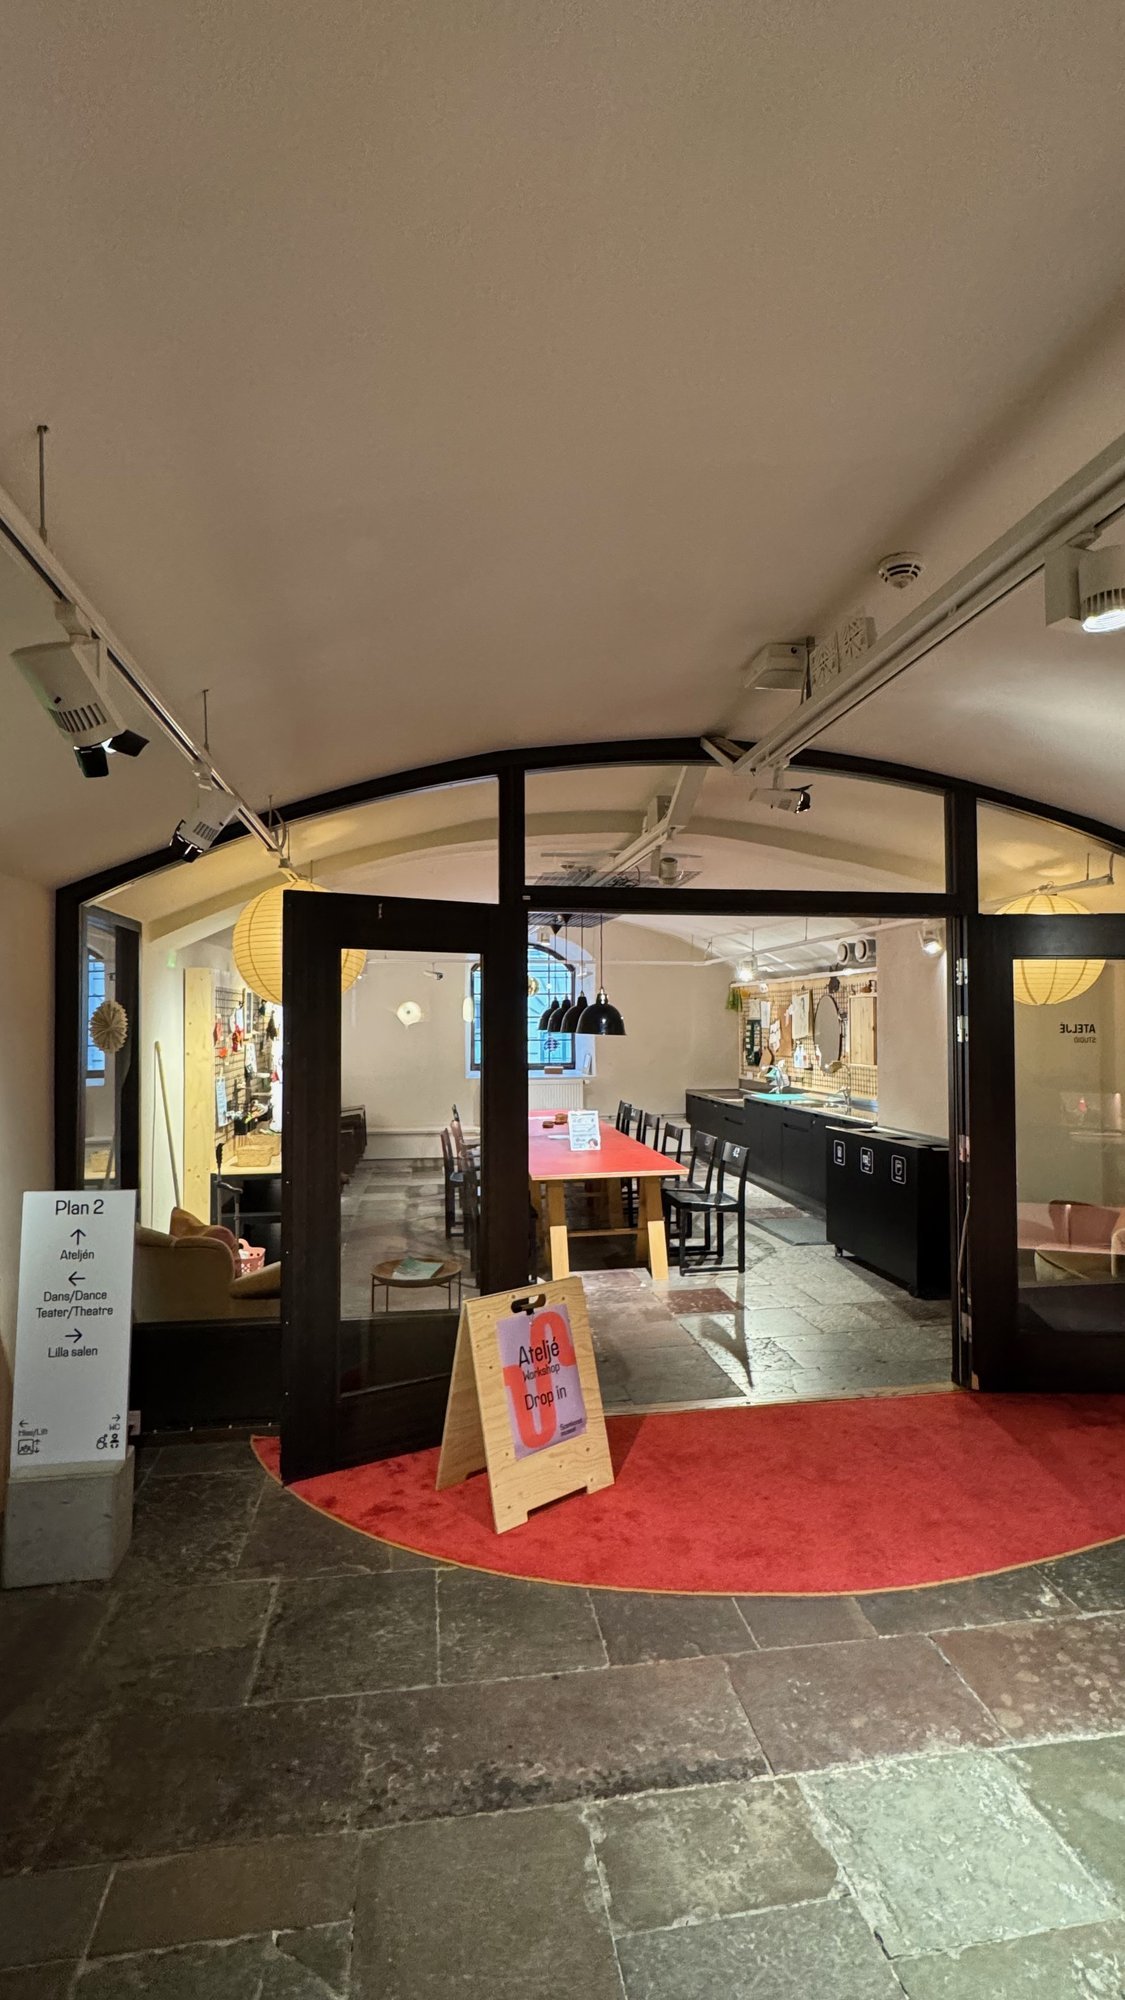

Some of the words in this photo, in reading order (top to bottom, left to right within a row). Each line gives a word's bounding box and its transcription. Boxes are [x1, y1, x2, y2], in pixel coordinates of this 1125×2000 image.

[55, 1199, 89, 1215] Plan
[93, 1199, 104, 1215] 2
[60, 1249, 95, 1262] Ateljén
[43, 1290, 107, 1303] Dans/Dance
[36, 1306, 113, 1319] Teater/Theatre
[48, 1347, 69, 1358] Lilla
[71, 1346, 98, 1357] salen
[518, 1336, 560, 1368] Ateljé
[523, 1363, 561, 1383] Workshop
[524, 1391, 554, 1411] Drop
[555, 1385, 567, 1400] in
